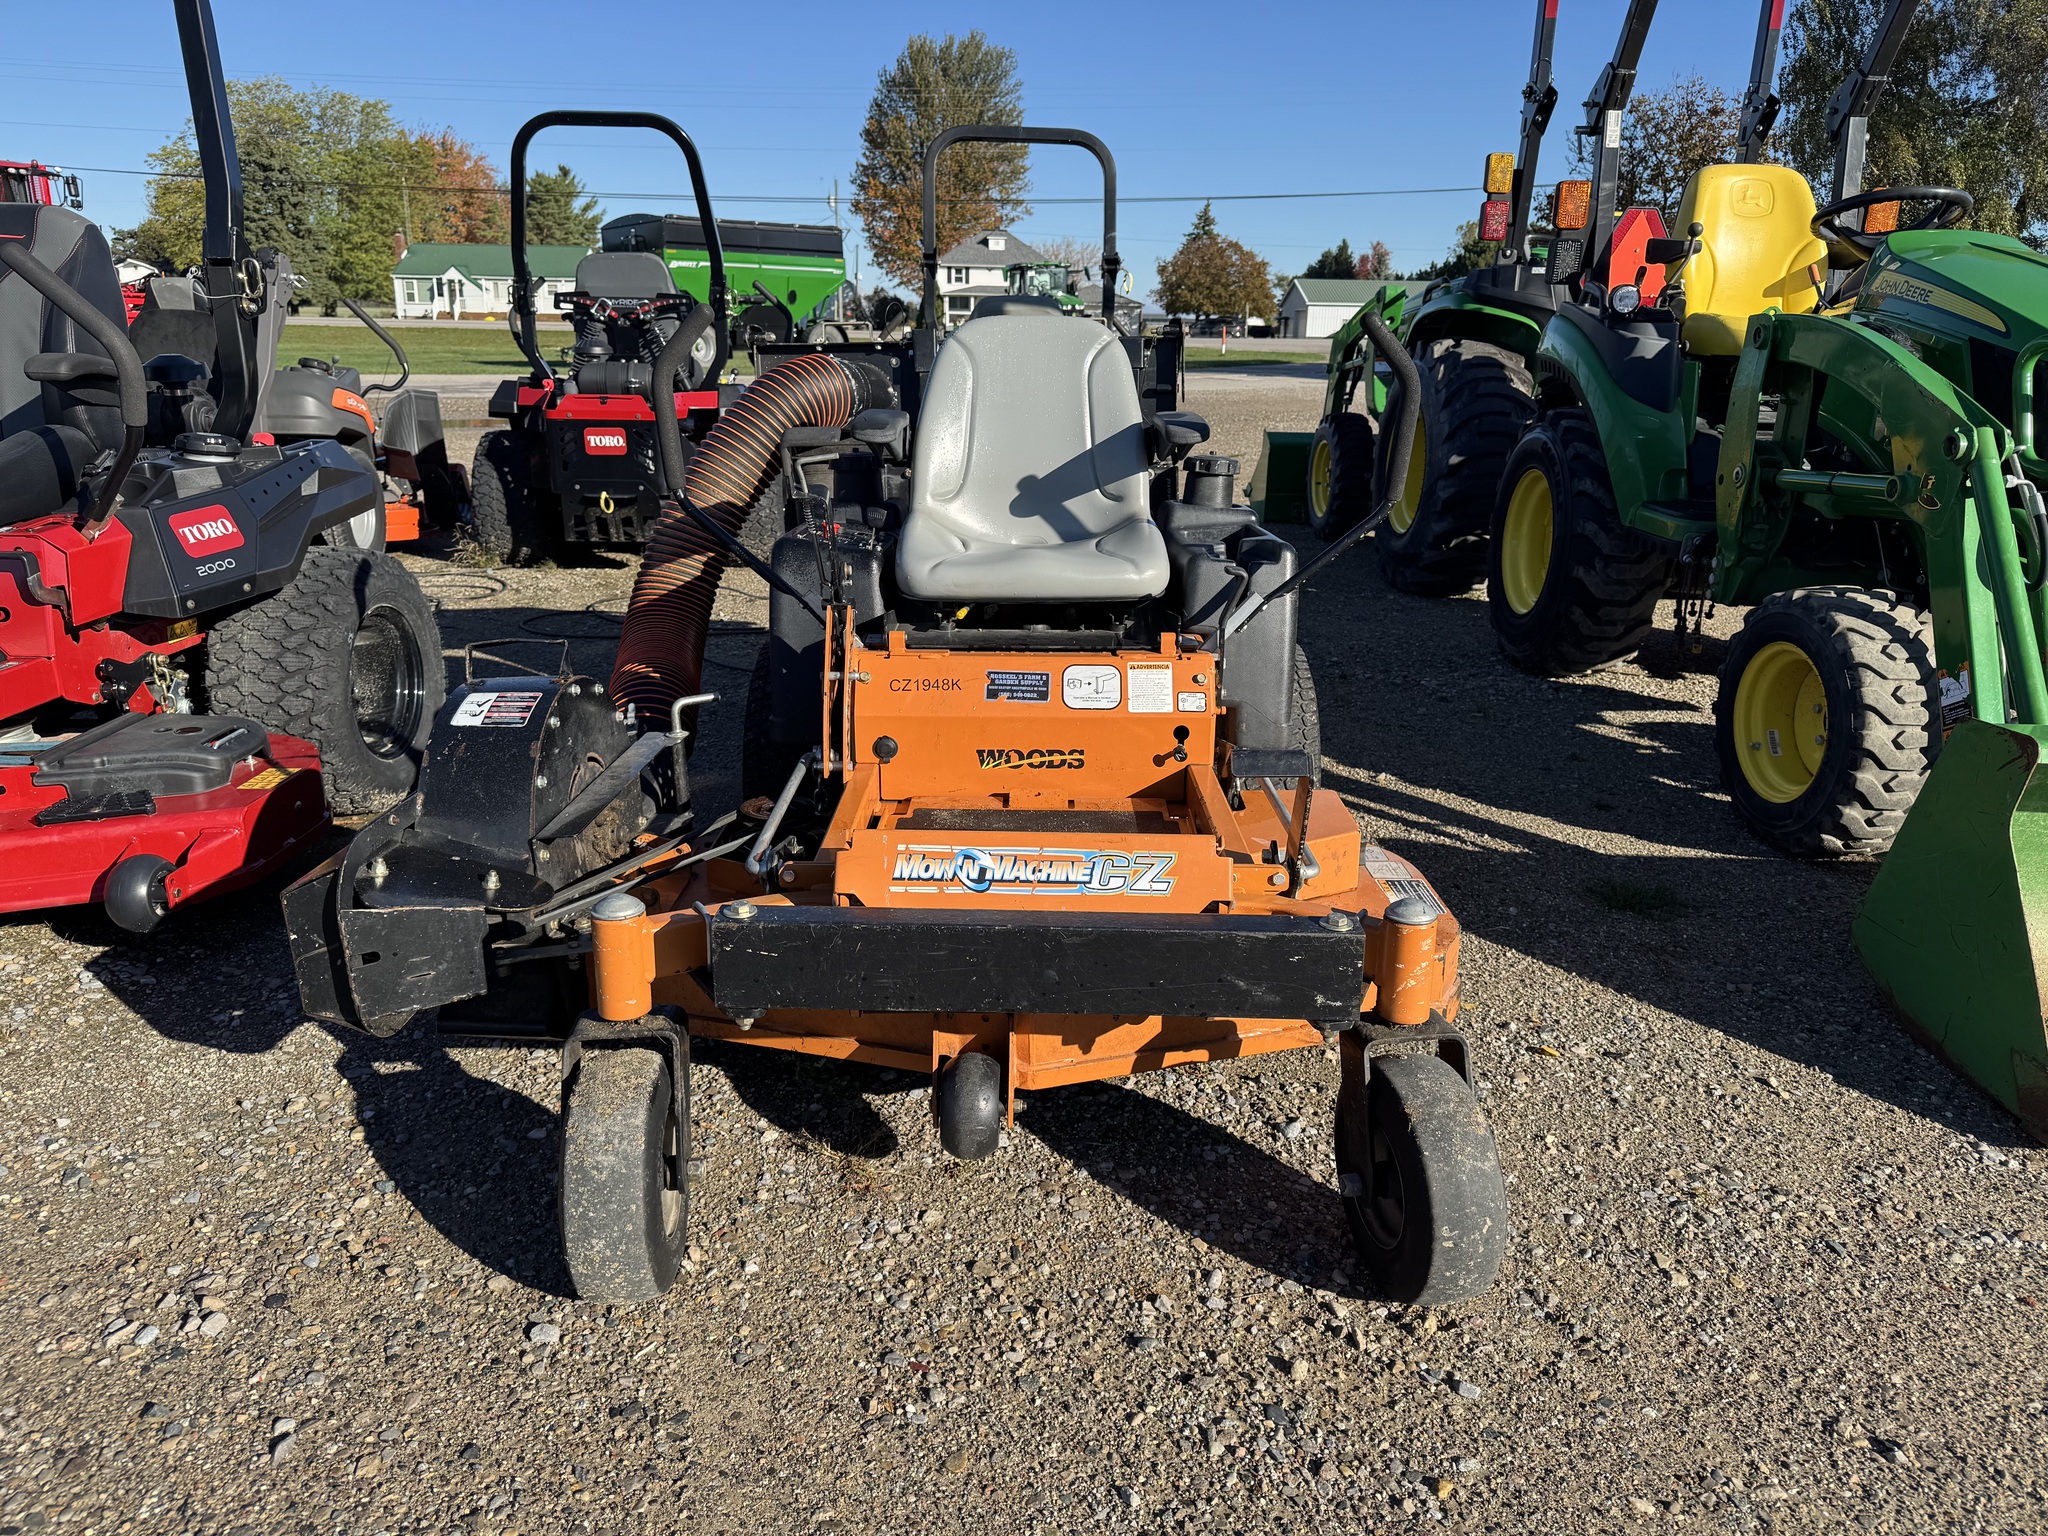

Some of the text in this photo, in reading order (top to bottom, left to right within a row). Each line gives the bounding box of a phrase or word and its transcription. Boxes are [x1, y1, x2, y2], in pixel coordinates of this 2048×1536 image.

[1876, 277, 1933, 303] JOHN DEERE
[587, 435, 624, 447] TORO
[179, 518, 233, 544] TORO
[195, 558, 236, 577] 2000
[889, 678, 962, 692] CZ1948K
[976, 749, 1085, 769] WOODS
[988, 854, 1095, 883] MACHINE
[1085, 852, 1177, 893] CZ
